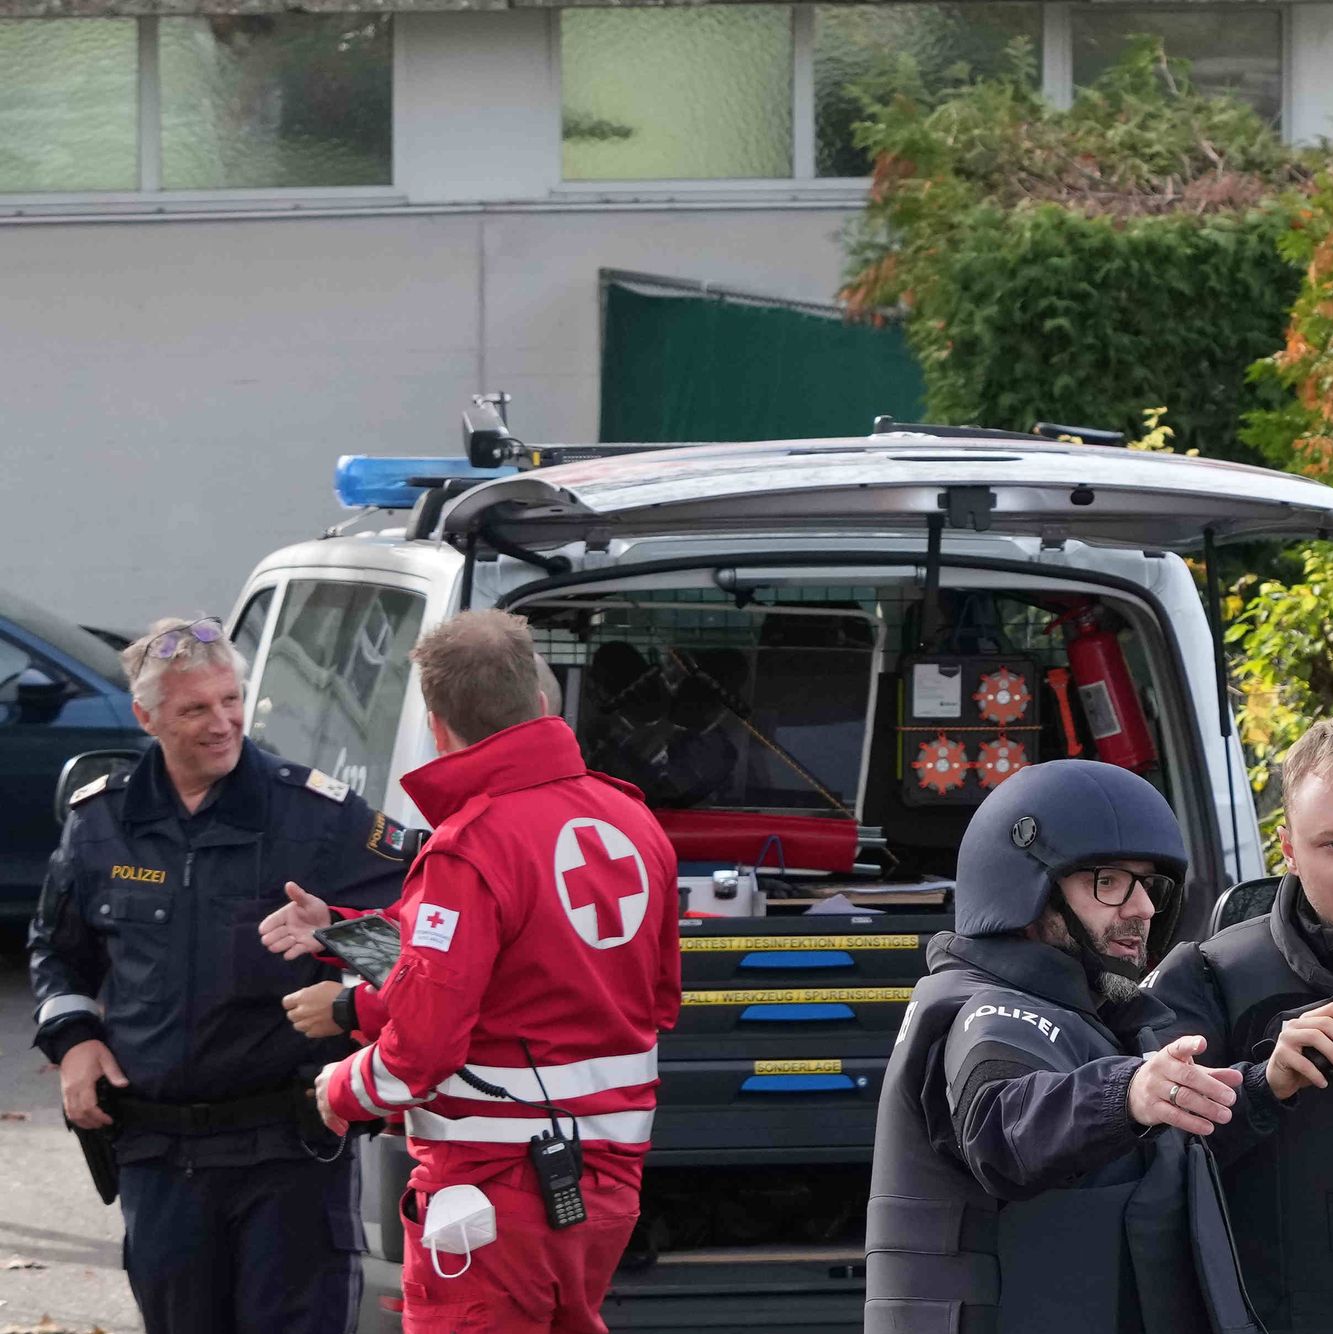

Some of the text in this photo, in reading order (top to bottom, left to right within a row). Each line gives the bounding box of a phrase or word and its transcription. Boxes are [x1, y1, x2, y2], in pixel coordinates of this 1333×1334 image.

[111, 865, 166, 884] POLIZEI
[746, 938, 835, 949] DESINFEKTION
[847, 937, 918, 948] SONSTIGES
[722, 991, 793, 1002] WERKZEUG
[805, 990, 911, 1001] SPURENSICHERU
[964, 1005, 1061, 1043] POLIZEI
[757, 1062, 841, 1072] SONDERLAGE
